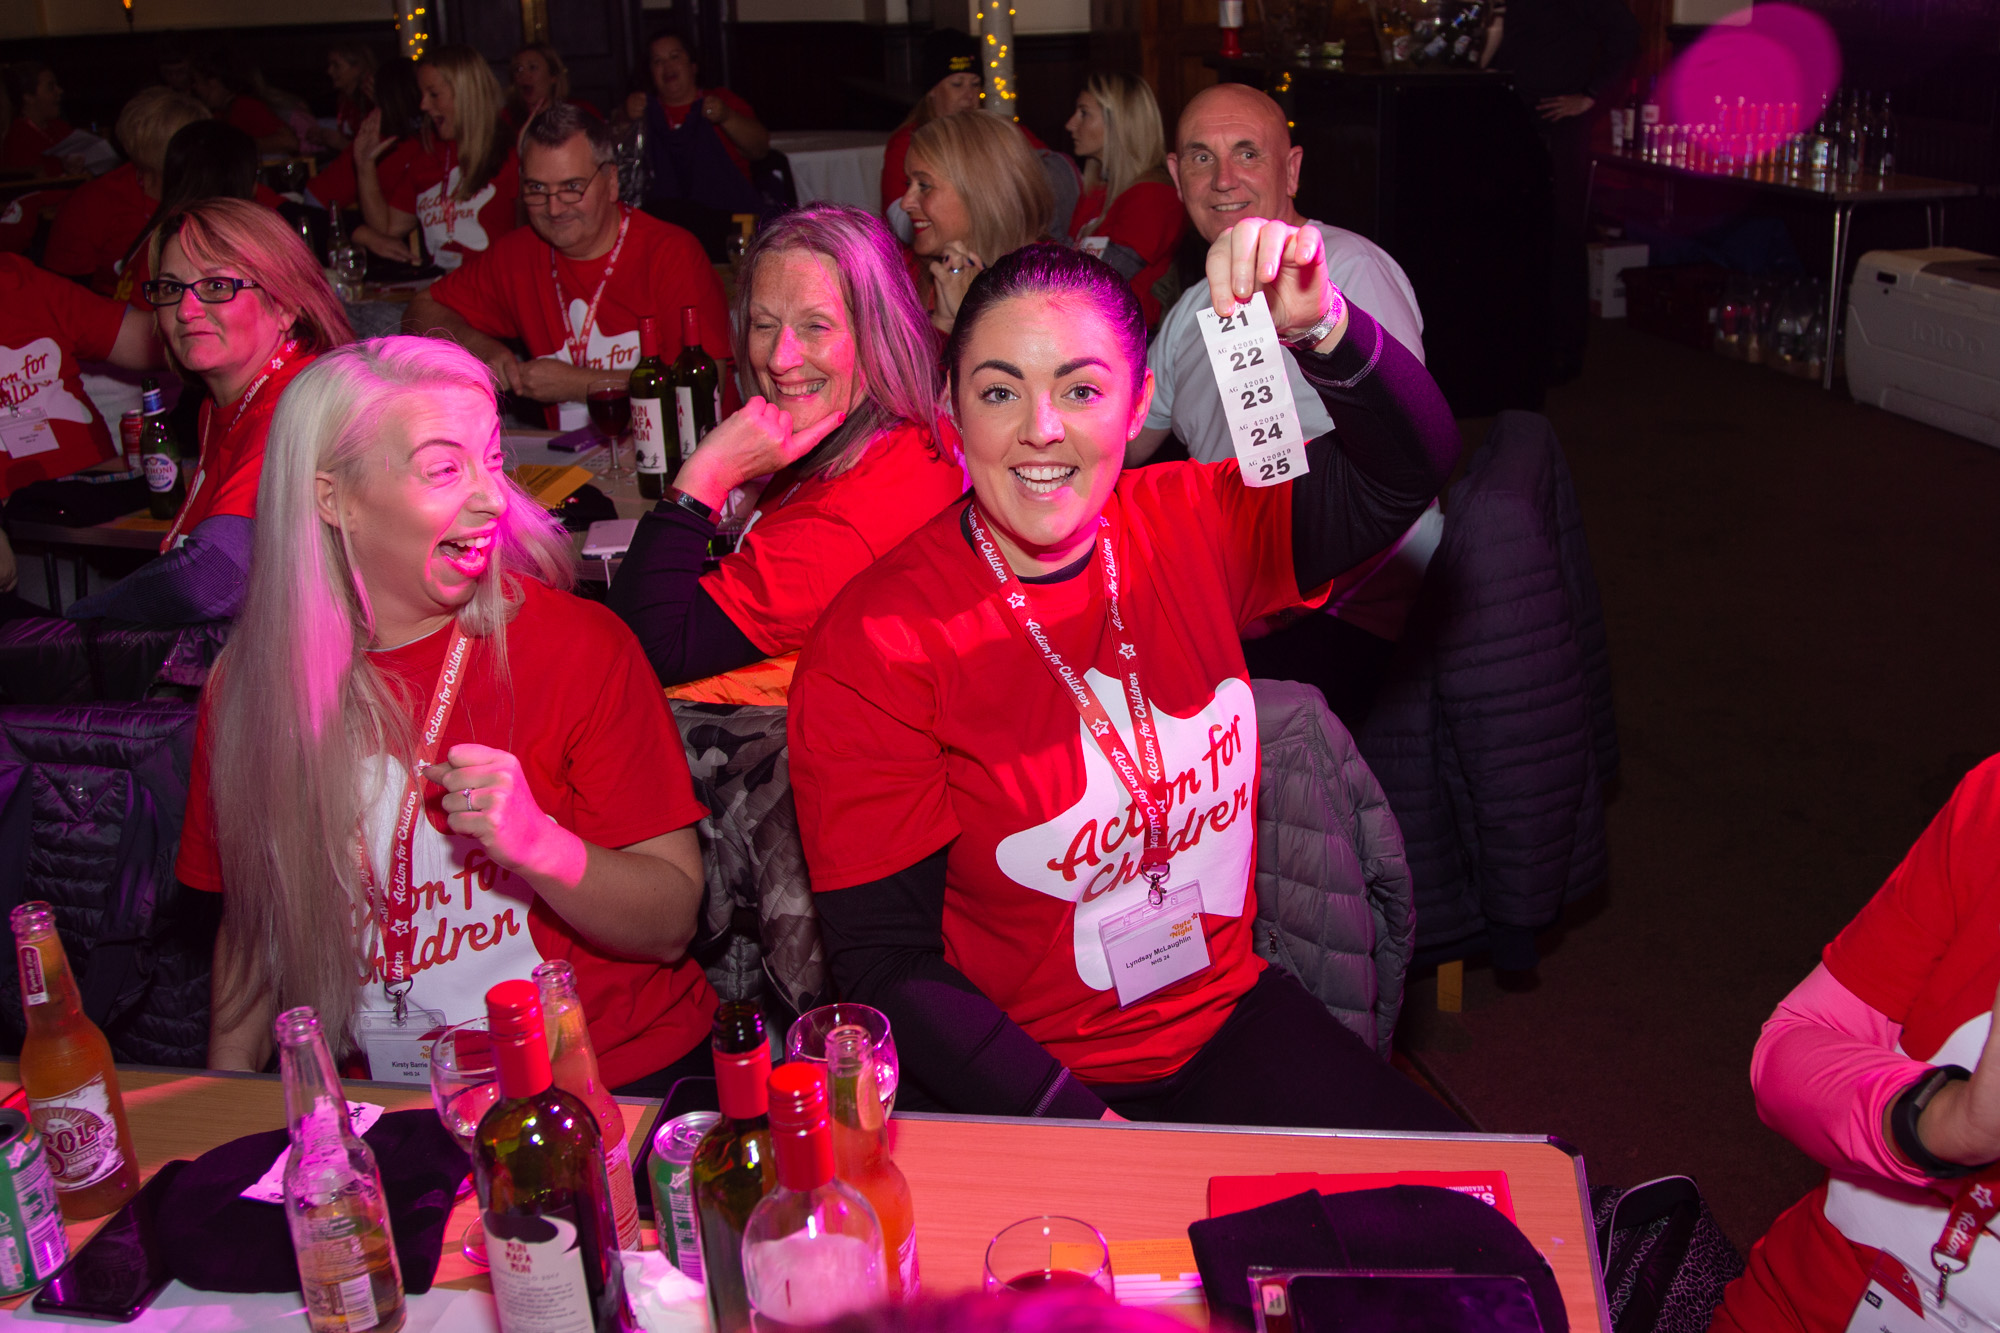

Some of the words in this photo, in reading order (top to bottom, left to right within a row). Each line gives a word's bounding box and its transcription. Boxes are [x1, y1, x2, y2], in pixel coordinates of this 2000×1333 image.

[1218, 310, 1249, 333] 21
[1217, 347, 1227, 356] AG
[1232, 337, 1265, 351] 420919
[1229, 347, 1265, 372] 22
[1228, 386, 1239, 394] AG
[1243, 375, 1275, 389] 420919
[1240, 385, 1274, 410] 23
[1238, 423, 1249, 432] AG
[1254, 412, 1285, 426] 420919
[1250, 422, 1283, 447] 24
[1248, 460, 1258, 468] AG
[1261, 448, 1292, 463] 420919
[1259, 457, 1291, 481] 25
[971, 527, 986, 542] for
[980, 541, 1008, 584] Children
[1102, 538, 1118, 577] Children
[1107, 579, 1119, 597] for
[1111, 595, 1124, 631] Action
[443, 636, 468, 684] Children
[1025, 618, 1053, 659] Action
[1045, 651, 1064, 670] for
[1058, 665, 1090, 708] Children
[438, 682, 452, 705] for
[1127, 672, 1147, 719] Children
[424, 701, 447, 746] Action
[1138, 719, 1156, 741] for
[1144, 738, 1161, 784] Action
[1201, 714, 1242, 792] for
[1111, 747, 1138, 789] Action
[1132, 788, 1151, 807] for
[1146, 805, 1164, 848] Children
[397, 790, 419, 842] Children
[393, 839, 411, 862] for
[1081, 782, 1249, 903] Chdren
[393, 861, 410, 905] Action
[1169, 925, 1193, 939] Night
[1125, 952, 1153, 969] Lyndsay
[1153, 935, 1192, 956] McLaughlin
[1150, 957, 1163, 966] NHS
[391, 1061, 409, 1069] Kirsty
[1946, 1210, 1976, 1256] Action
